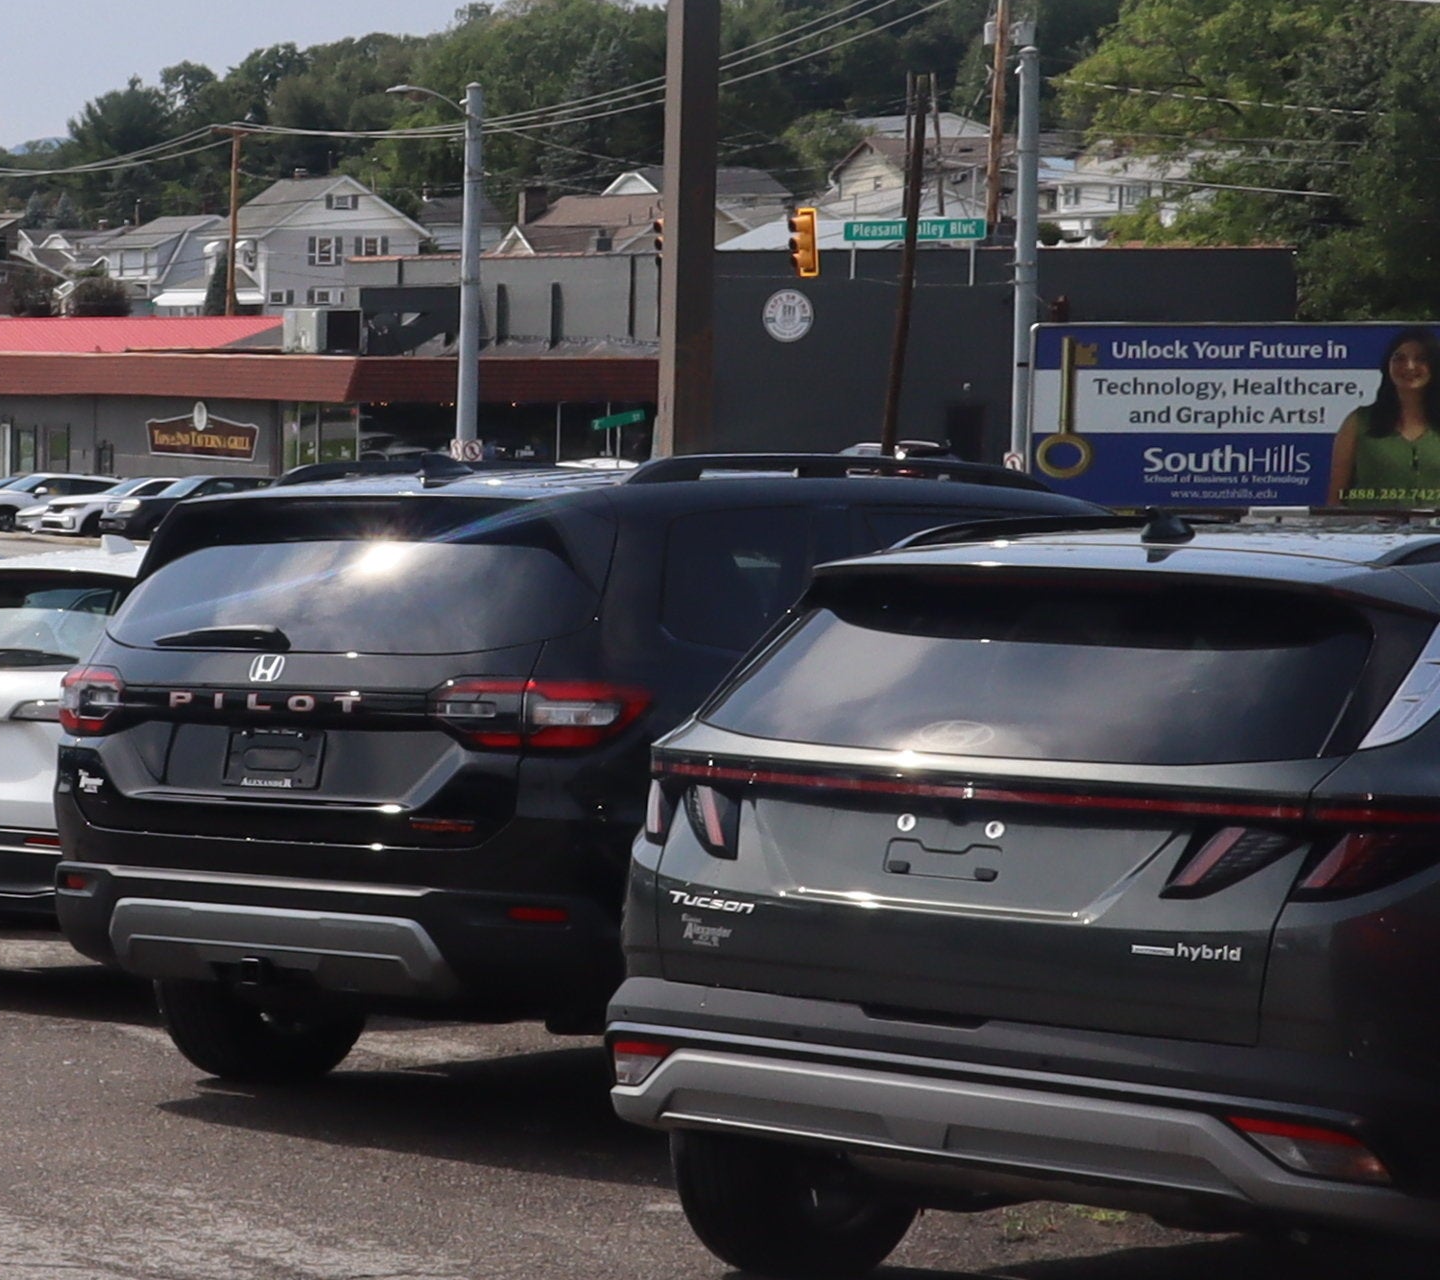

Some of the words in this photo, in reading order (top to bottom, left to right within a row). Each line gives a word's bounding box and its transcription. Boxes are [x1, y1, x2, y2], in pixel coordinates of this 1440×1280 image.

[852, 223, 903, 237] Pleasant
[916, 221, 945, 238] alley
[1111, 341, 1189, 360] Unlock
[1193, 342, 1244, 360] Your
[1249, 342, 1324, 360] Future
[1327, 340, 1348, 360] in
[1093, 377, 1227, 401] Technology,
[1233, 376, 1365, 398] Healthcare,
[1130, 406, 1171, 424] and
[1176, 407, 1265, 429] Graphic
[1270, 406, 1326, 424] Arts!
[1143, 444, 1311, 473] SouthHills
[1144, 474, 1178, 483] School
[1180, 474, 1191, 483] of
[1193, 474, 1238, 484] Business
[1241, 474, 1249, 483] &
[1252, 474, 1310, 486] Technology
[169, 691, 361, 714] PILOT
[1176, 942, 1242, 961] hybrid
